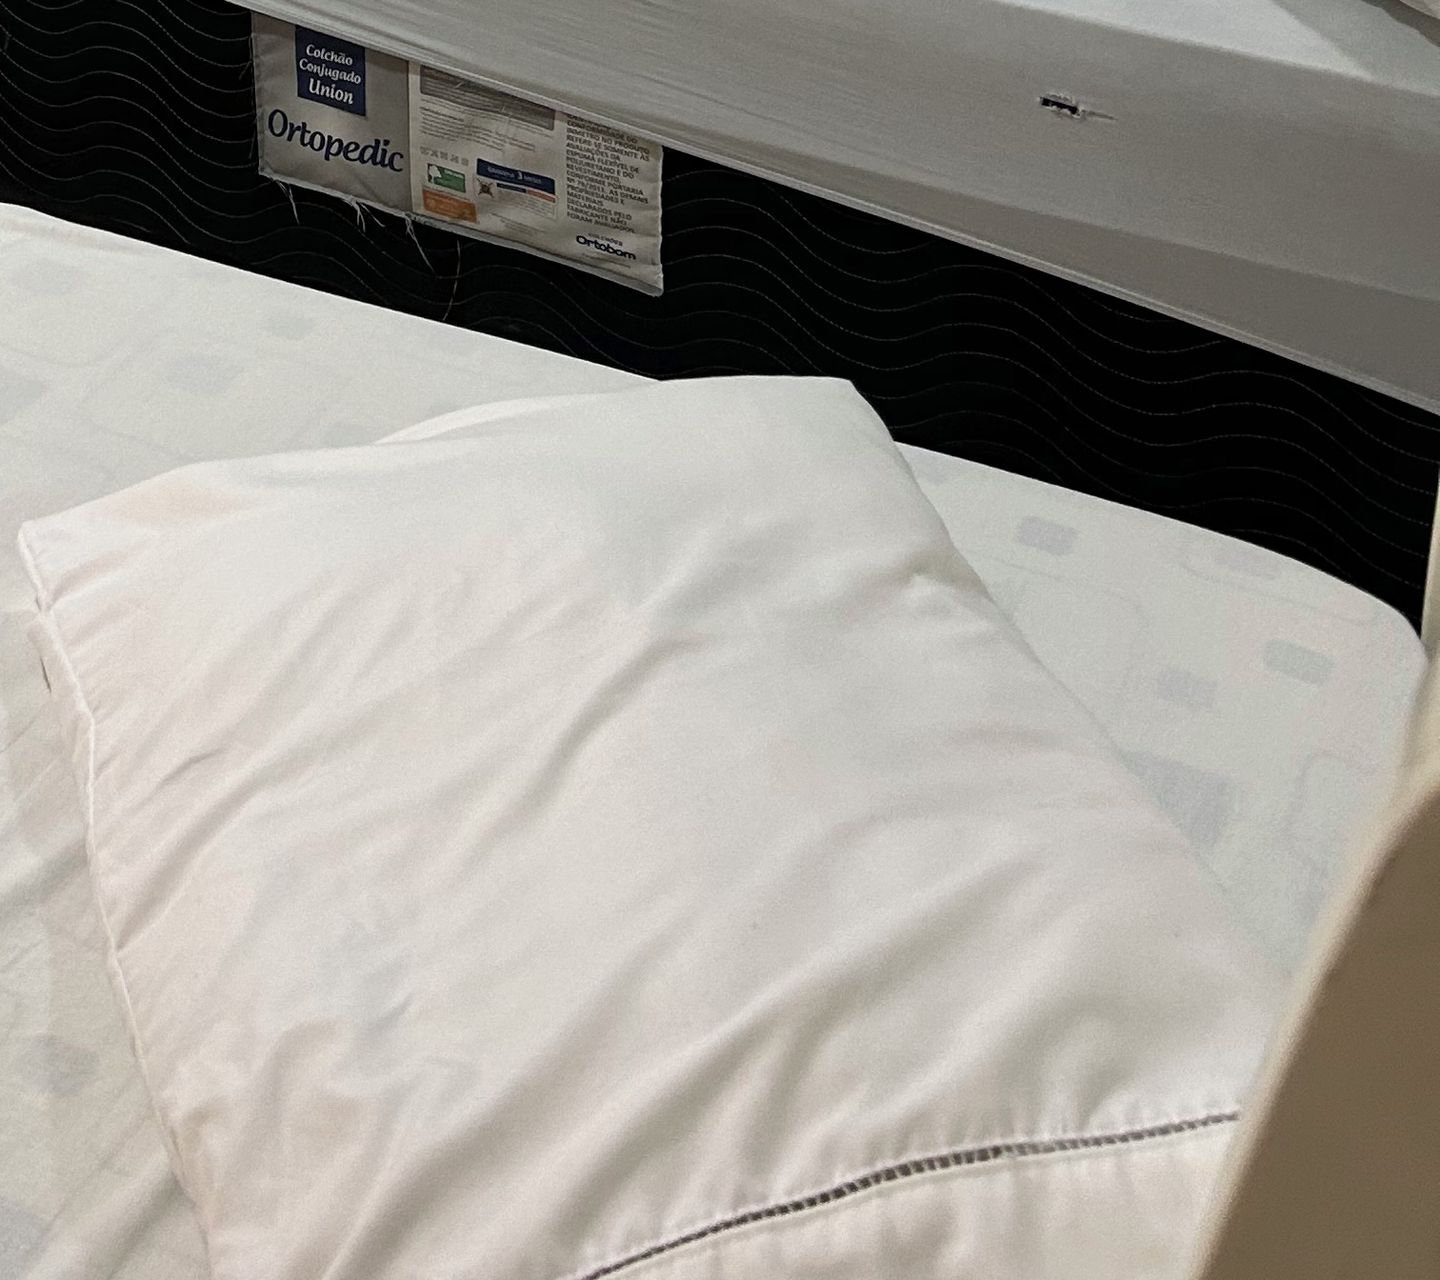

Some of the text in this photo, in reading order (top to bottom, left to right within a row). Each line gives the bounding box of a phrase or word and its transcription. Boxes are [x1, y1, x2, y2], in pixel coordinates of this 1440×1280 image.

[306, 44, 353, 66] Colchão
[299, 57, 361, 85] Conjugado
[308, 78, 354, 105] Union
[267, 108, 404, 172] Ortopedic
[576, 235, 636, 260] Ortobom
